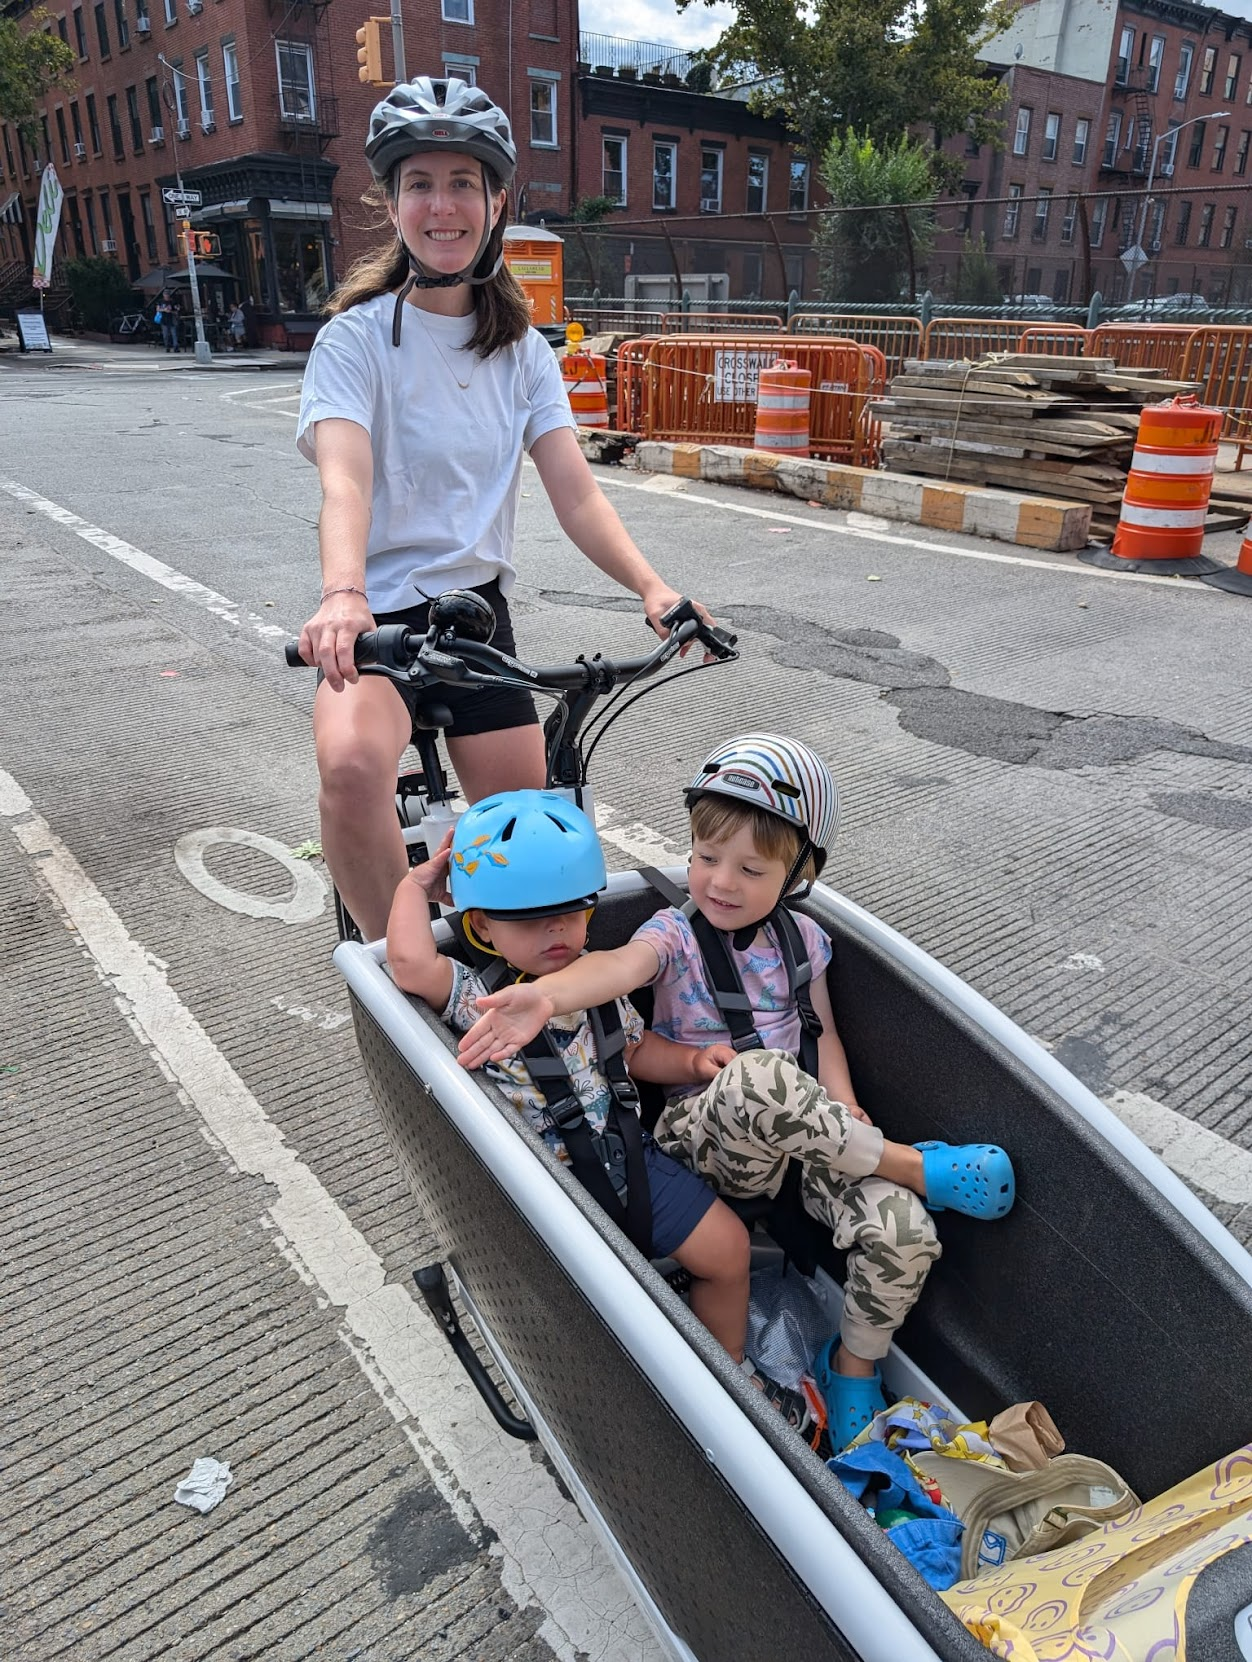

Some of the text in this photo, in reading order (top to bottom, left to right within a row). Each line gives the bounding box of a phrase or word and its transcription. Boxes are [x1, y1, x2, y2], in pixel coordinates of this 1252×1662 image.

[724, 372, 759, 385] CLOSE
[717, 386, 756, 397] USE OTHER
